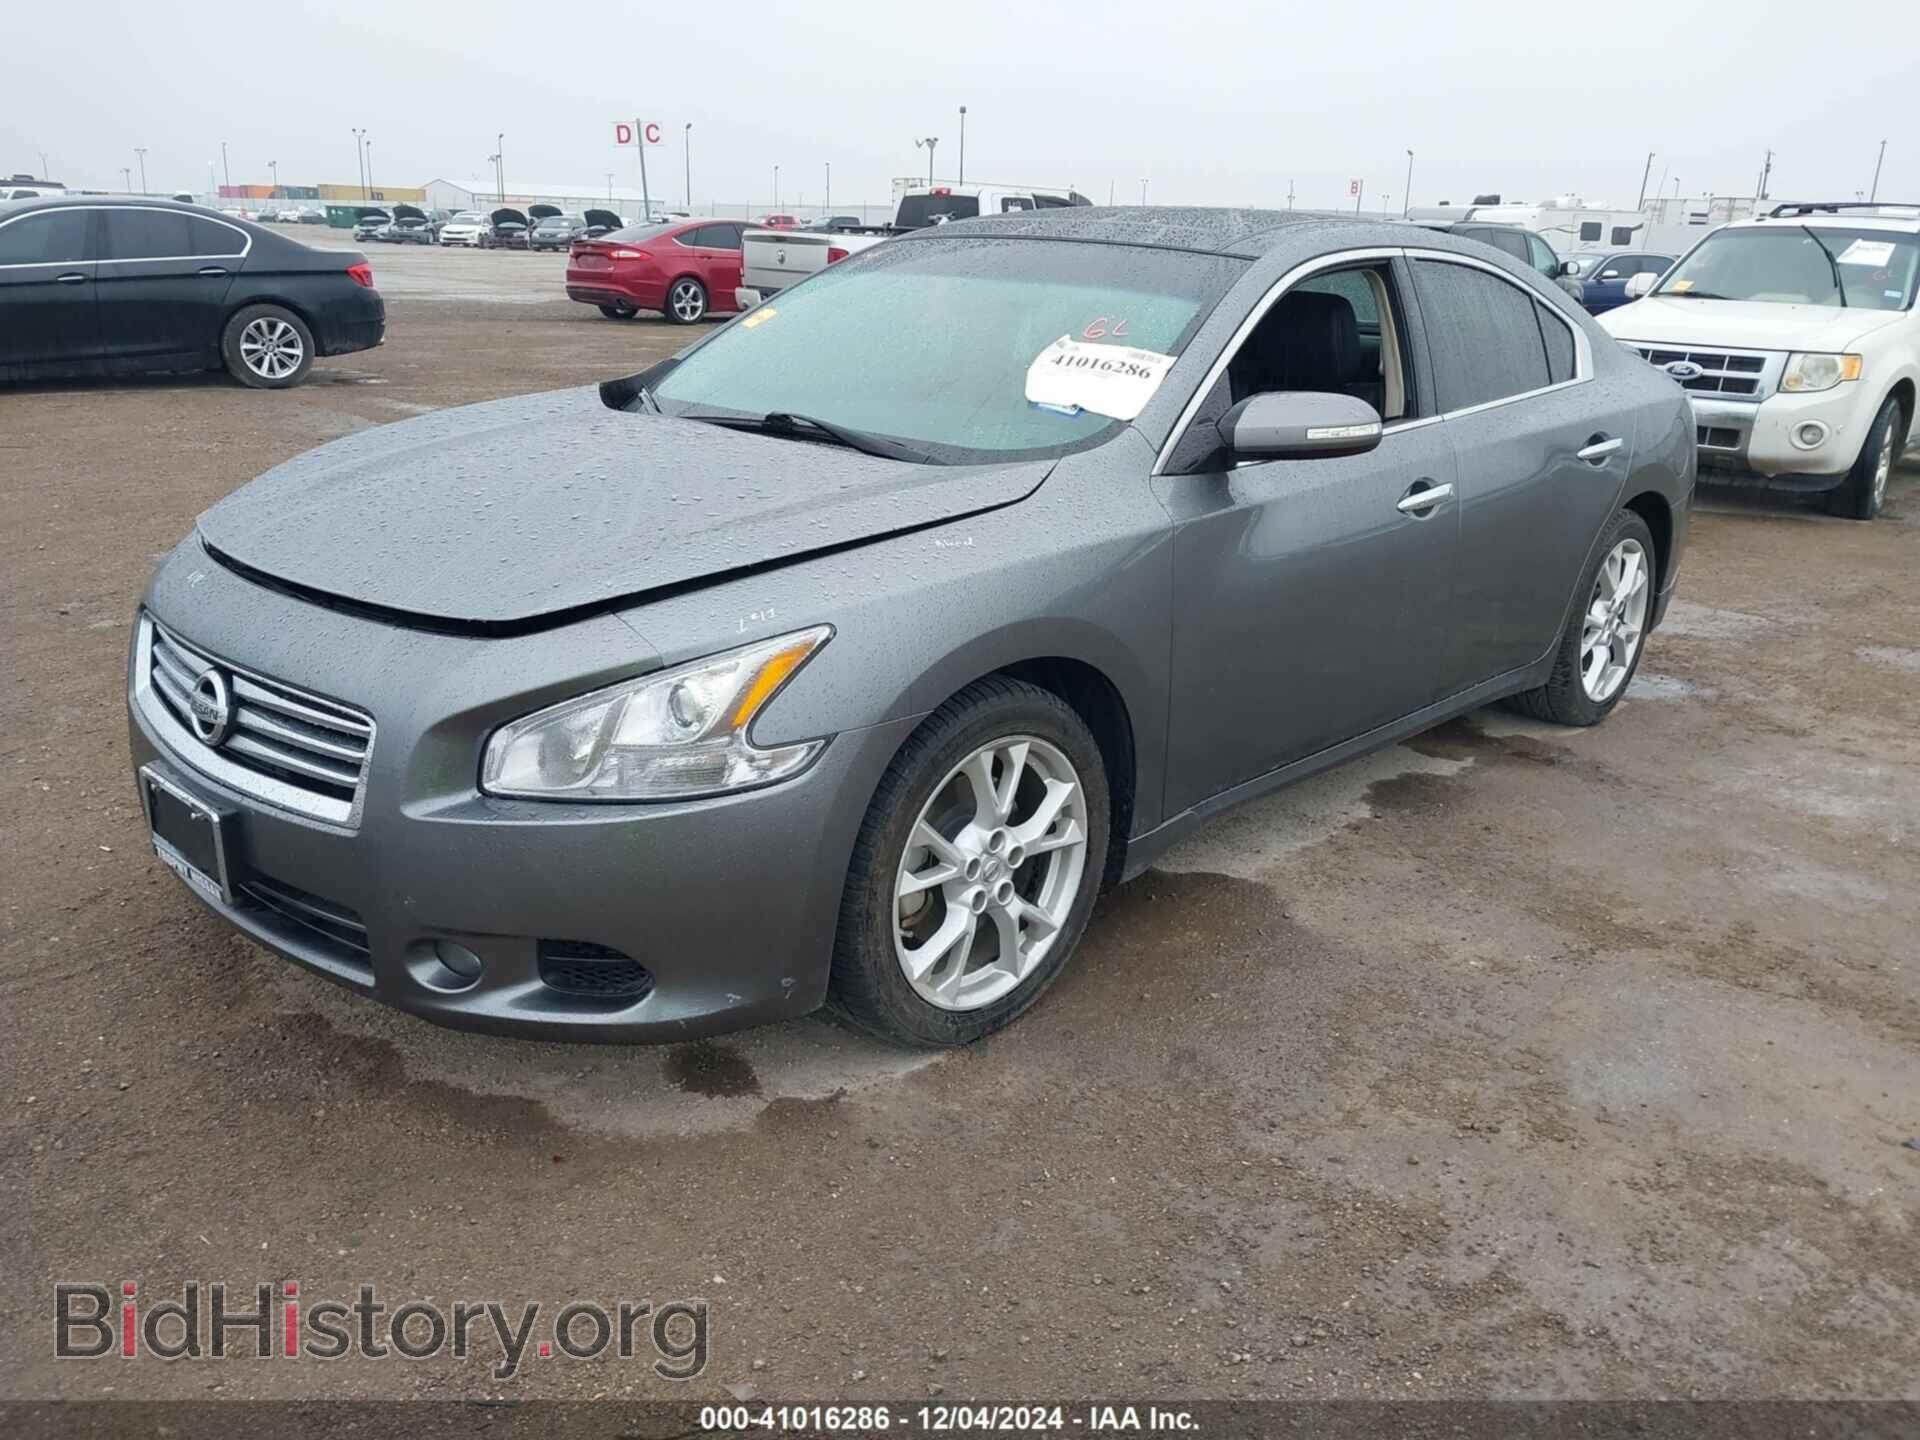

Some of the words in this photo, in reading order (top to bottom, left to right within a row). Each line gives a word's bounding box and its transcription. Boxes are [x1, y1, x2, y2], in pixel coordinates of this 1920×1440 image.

[616, 125, 631, 144] D
[646, 124, 660, 143] C
[1052, 354, 1151, 380] 41016286
